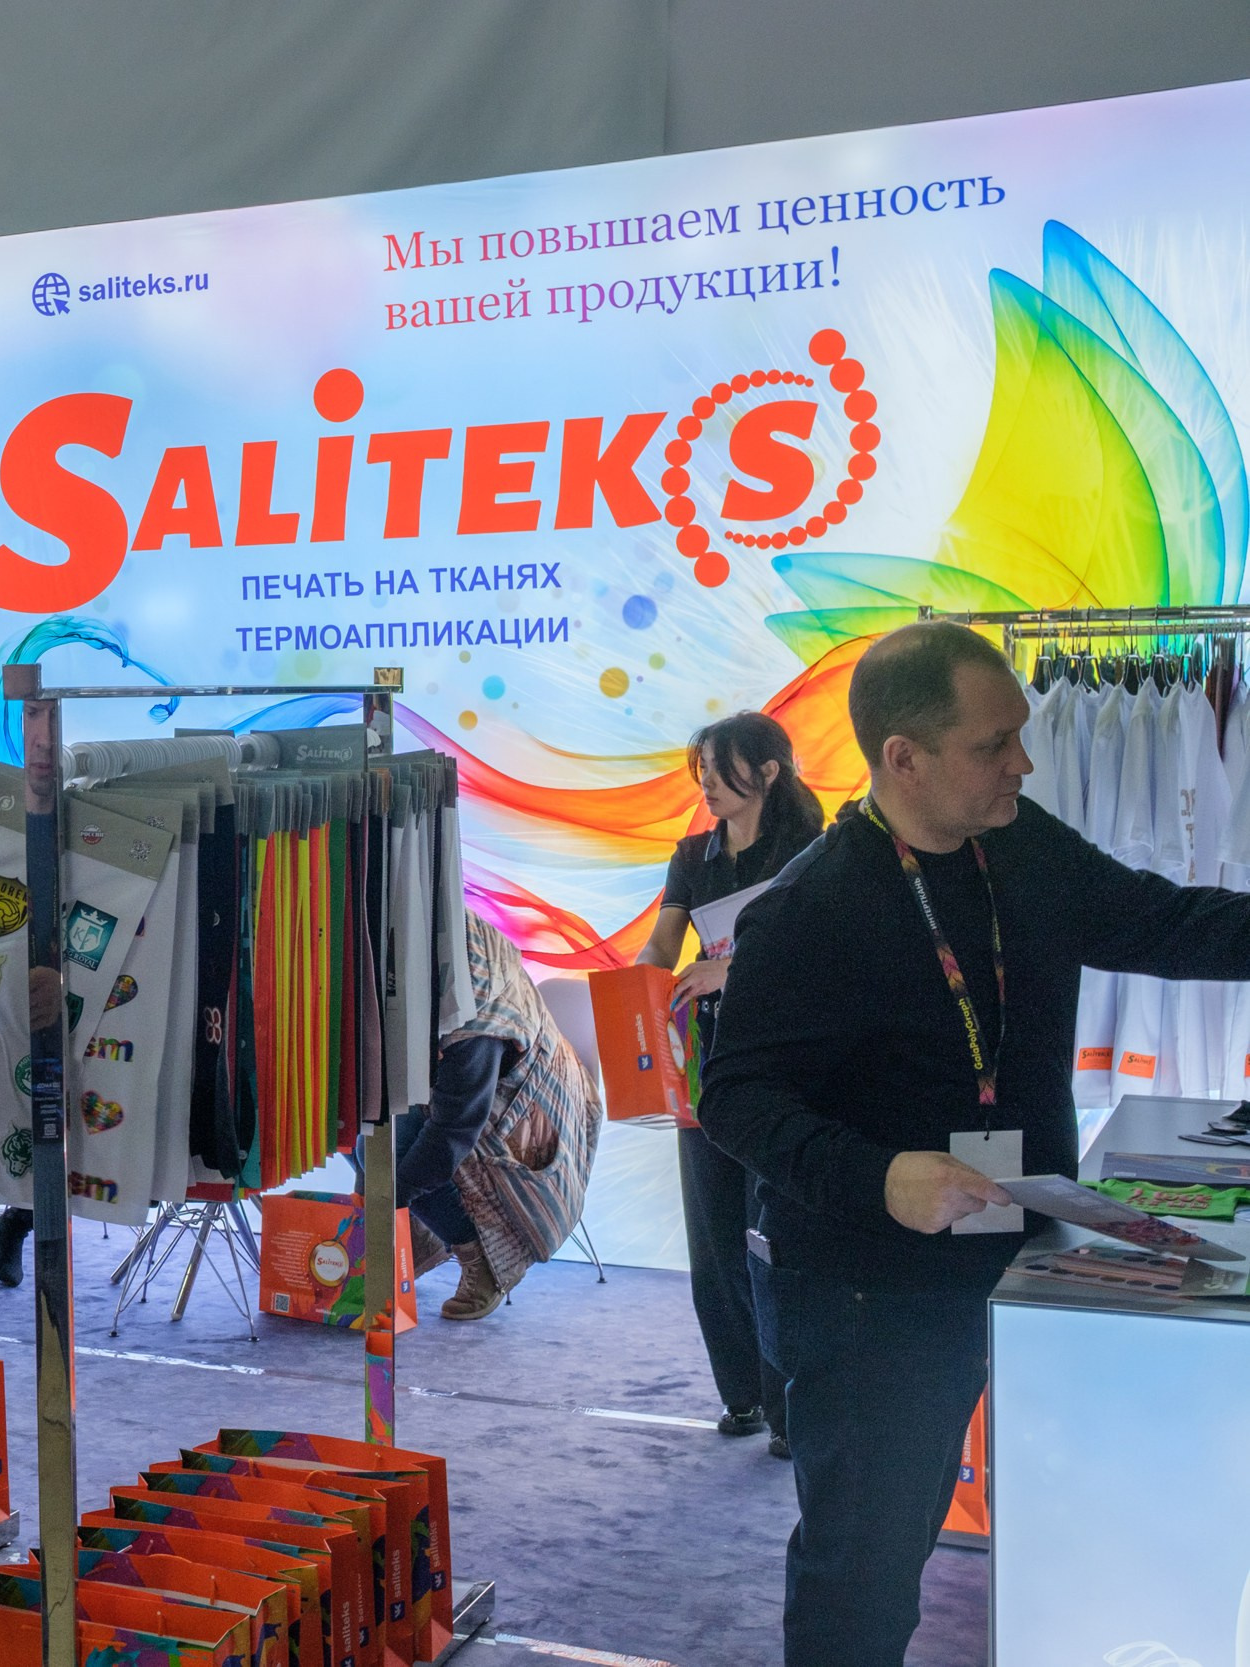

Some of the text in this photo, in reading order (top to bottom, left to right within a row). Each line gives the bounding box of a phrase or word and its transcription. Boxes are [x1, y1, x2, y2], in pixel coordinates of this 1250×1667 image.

[383, 176, 1006, 271] Мы повышаем ценность
[78, 273, 209, 303] saliteks.ru
[385, 245, 840, 330] вашей продукции!
[241, 562, 562, 601] ПЕЧАТЬ НА ТКАНЯХ
[235, 617, 569, 652] ТЕРМОАППЛИКАЦИИ
[914, 877, 937, 931] ИНТЕРТКАНЬ
[430, 1520, 441, 1568] saliteks
[391, 1549, 401, 1598] saliteks
[342, 1601, 350, 1653] saliteks
